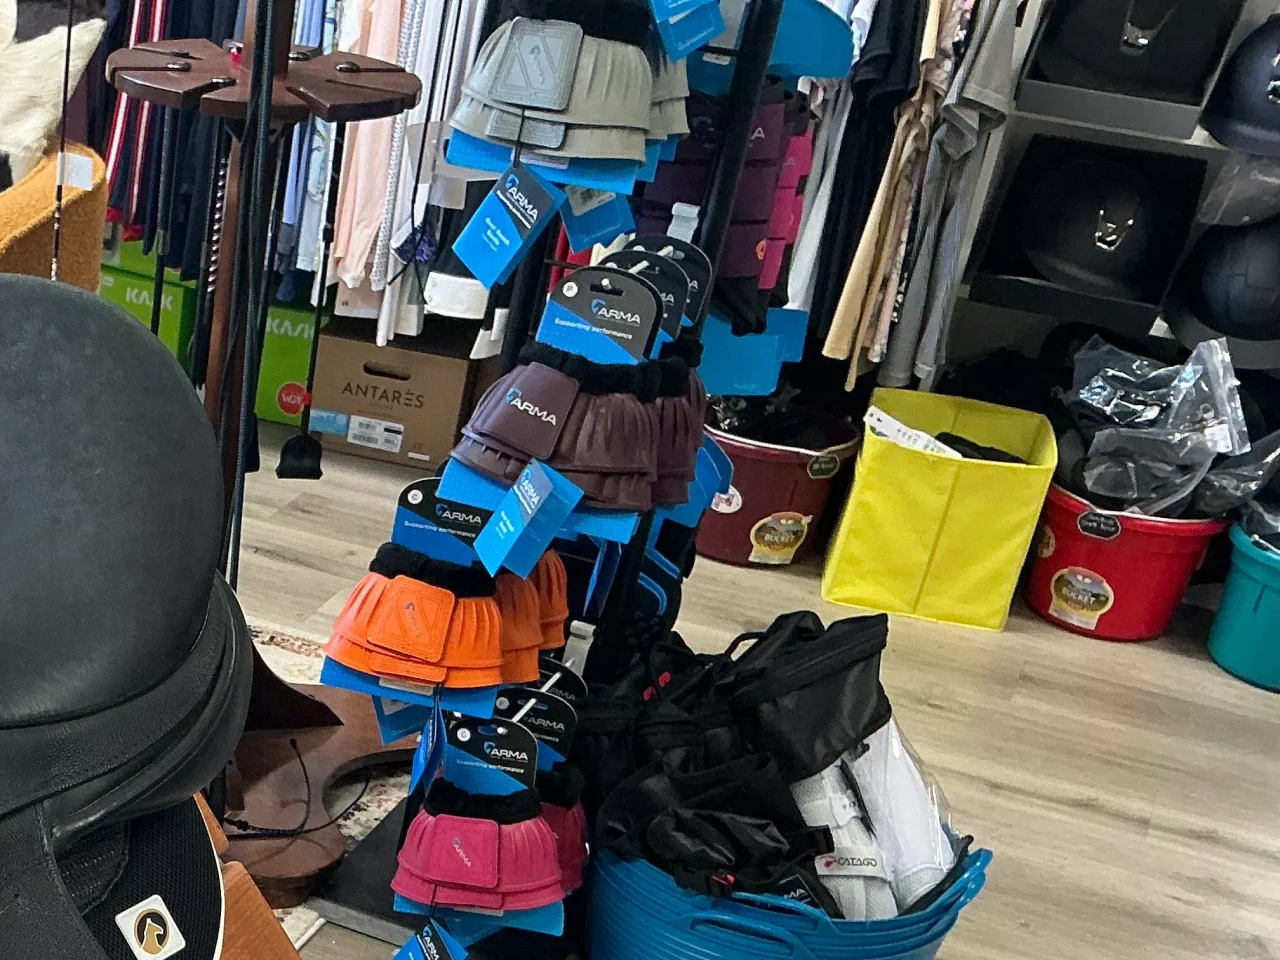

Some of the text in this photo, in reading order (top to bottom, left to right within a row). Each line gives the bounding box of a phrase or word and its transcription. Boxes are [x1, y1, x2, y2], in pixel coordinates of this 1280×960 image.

[507, 188, 539, 221] ARMA
[126, 287, 173, 311] KAK
[597, 307, 641, 324] ARMA
[591, 326, 633, 340] performance
[342, 382, 425, 409] ANTARÈS
[509, 397, 557, 426] ARMA
[441, 510, 482, 525] ARMA
[438, 527, 476, 538] performance
[527, 718, 565, 731] ARMA
[490, 749, 529, 761] ARMA
[837, 857, 878, 868] CATAGO
